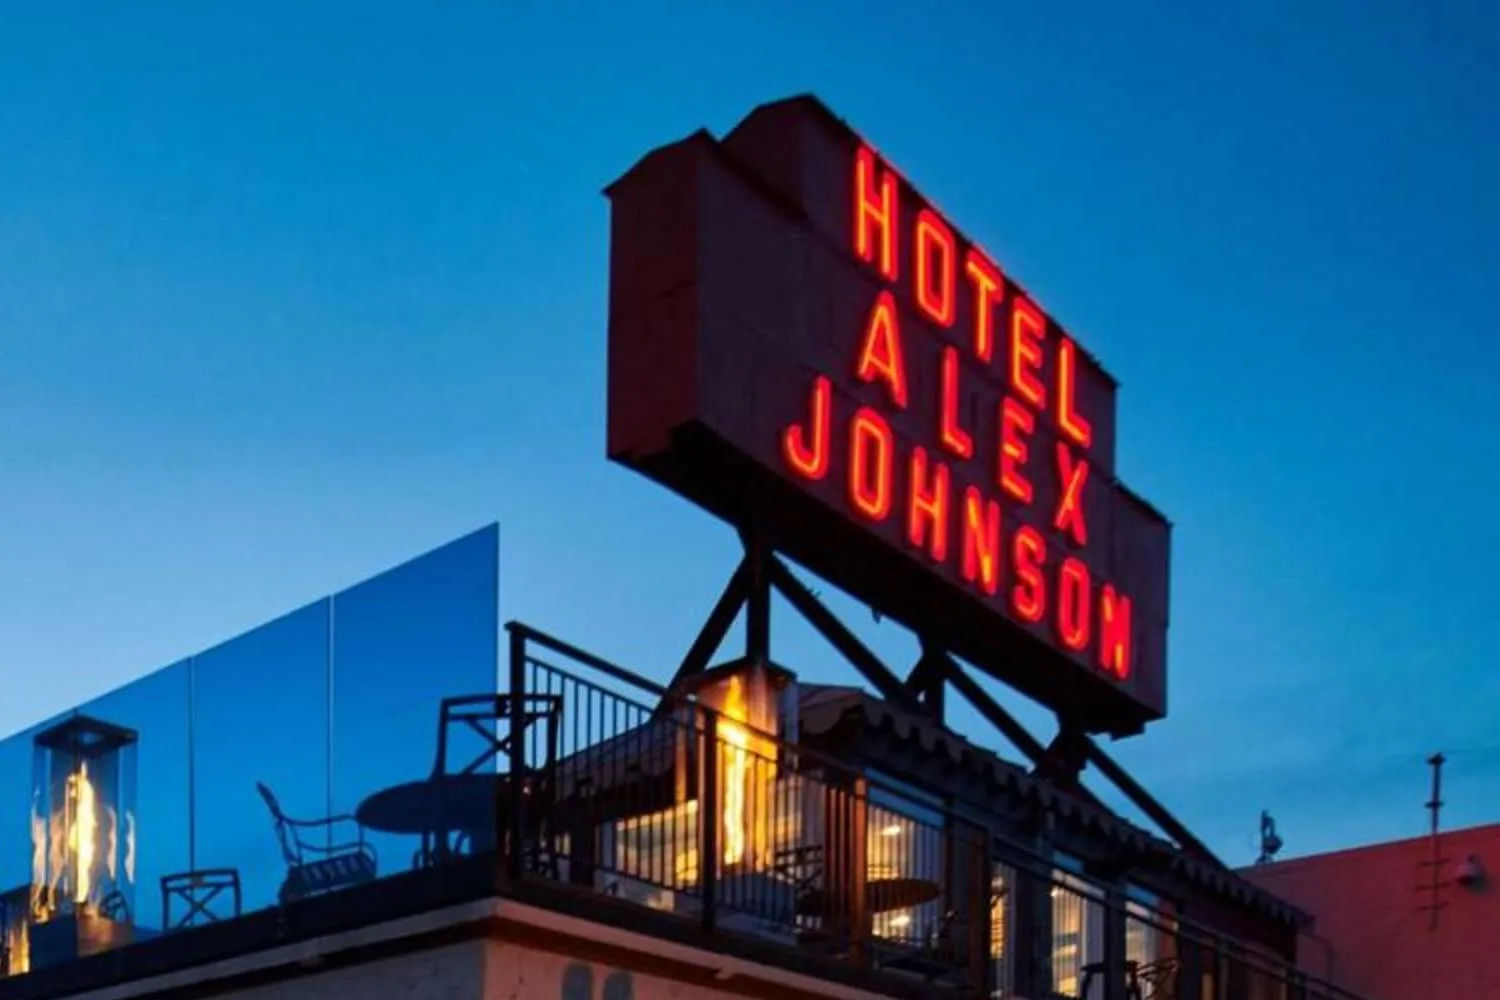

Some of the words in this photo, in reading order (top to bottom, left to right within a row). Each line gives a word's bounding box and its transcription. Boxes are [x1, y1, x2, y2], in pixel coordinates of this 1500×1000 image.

[853, 145, 1092, 449] HOTEL
[857, 289, 1090, 546] ALEX
[784, 376, 1134, 680] JOHNSON
